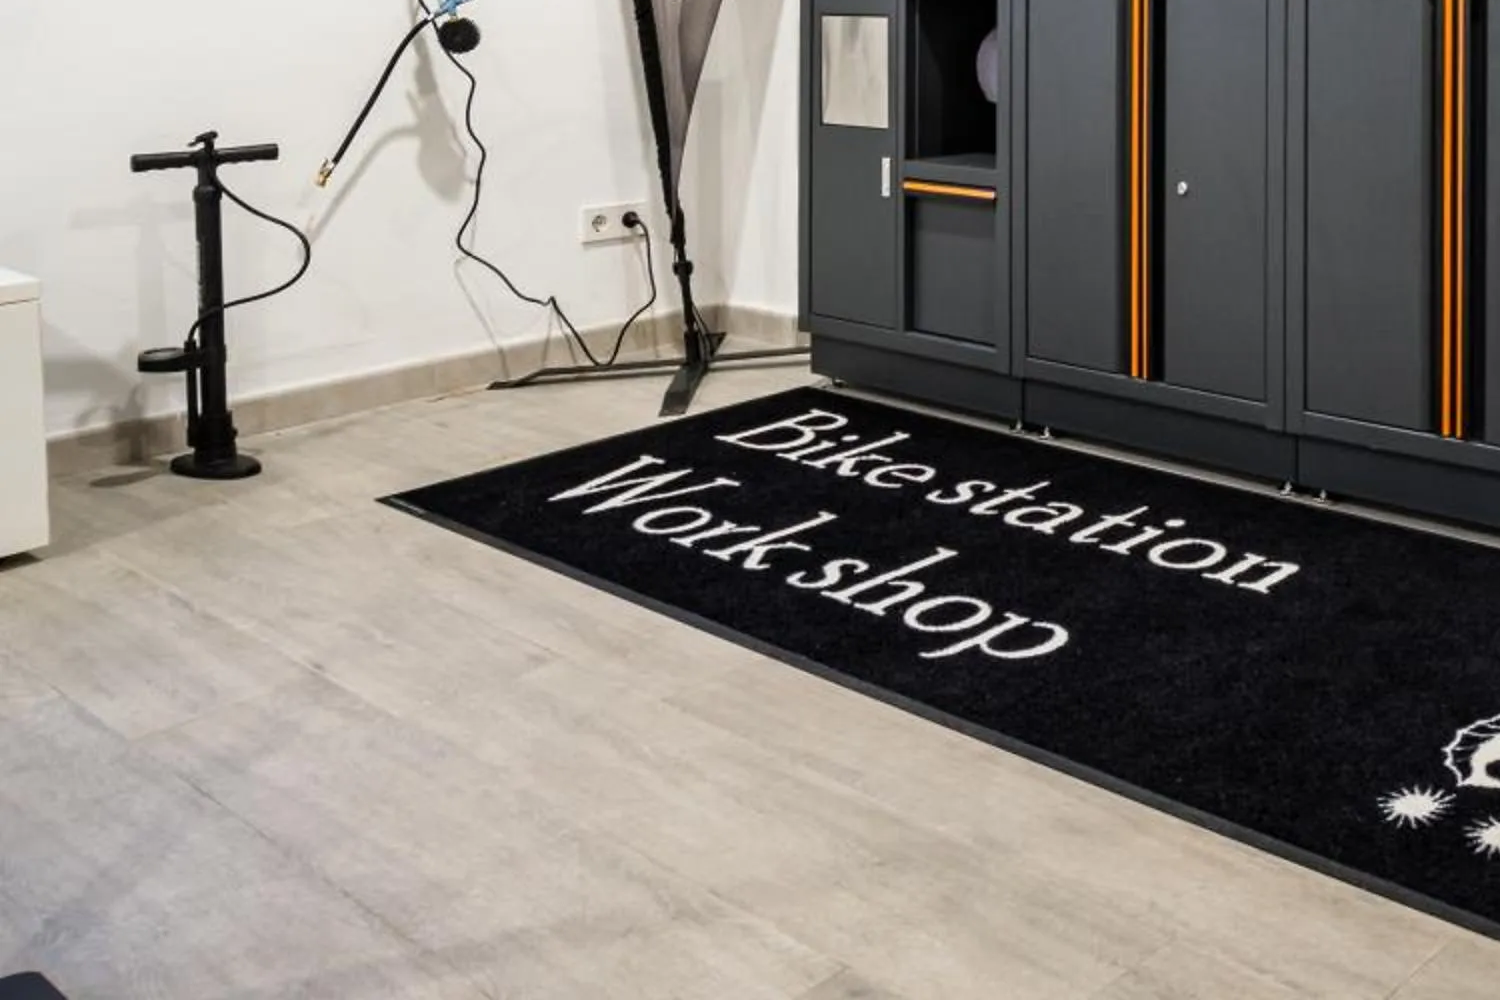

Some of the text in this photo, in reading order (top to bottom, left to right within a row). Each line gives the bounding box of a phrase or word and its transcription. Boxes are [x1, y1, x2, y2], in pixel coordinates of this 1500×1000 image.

[547, 454, 1070, 661] Work shop
[715, 408, 1300, 595] Bike station
